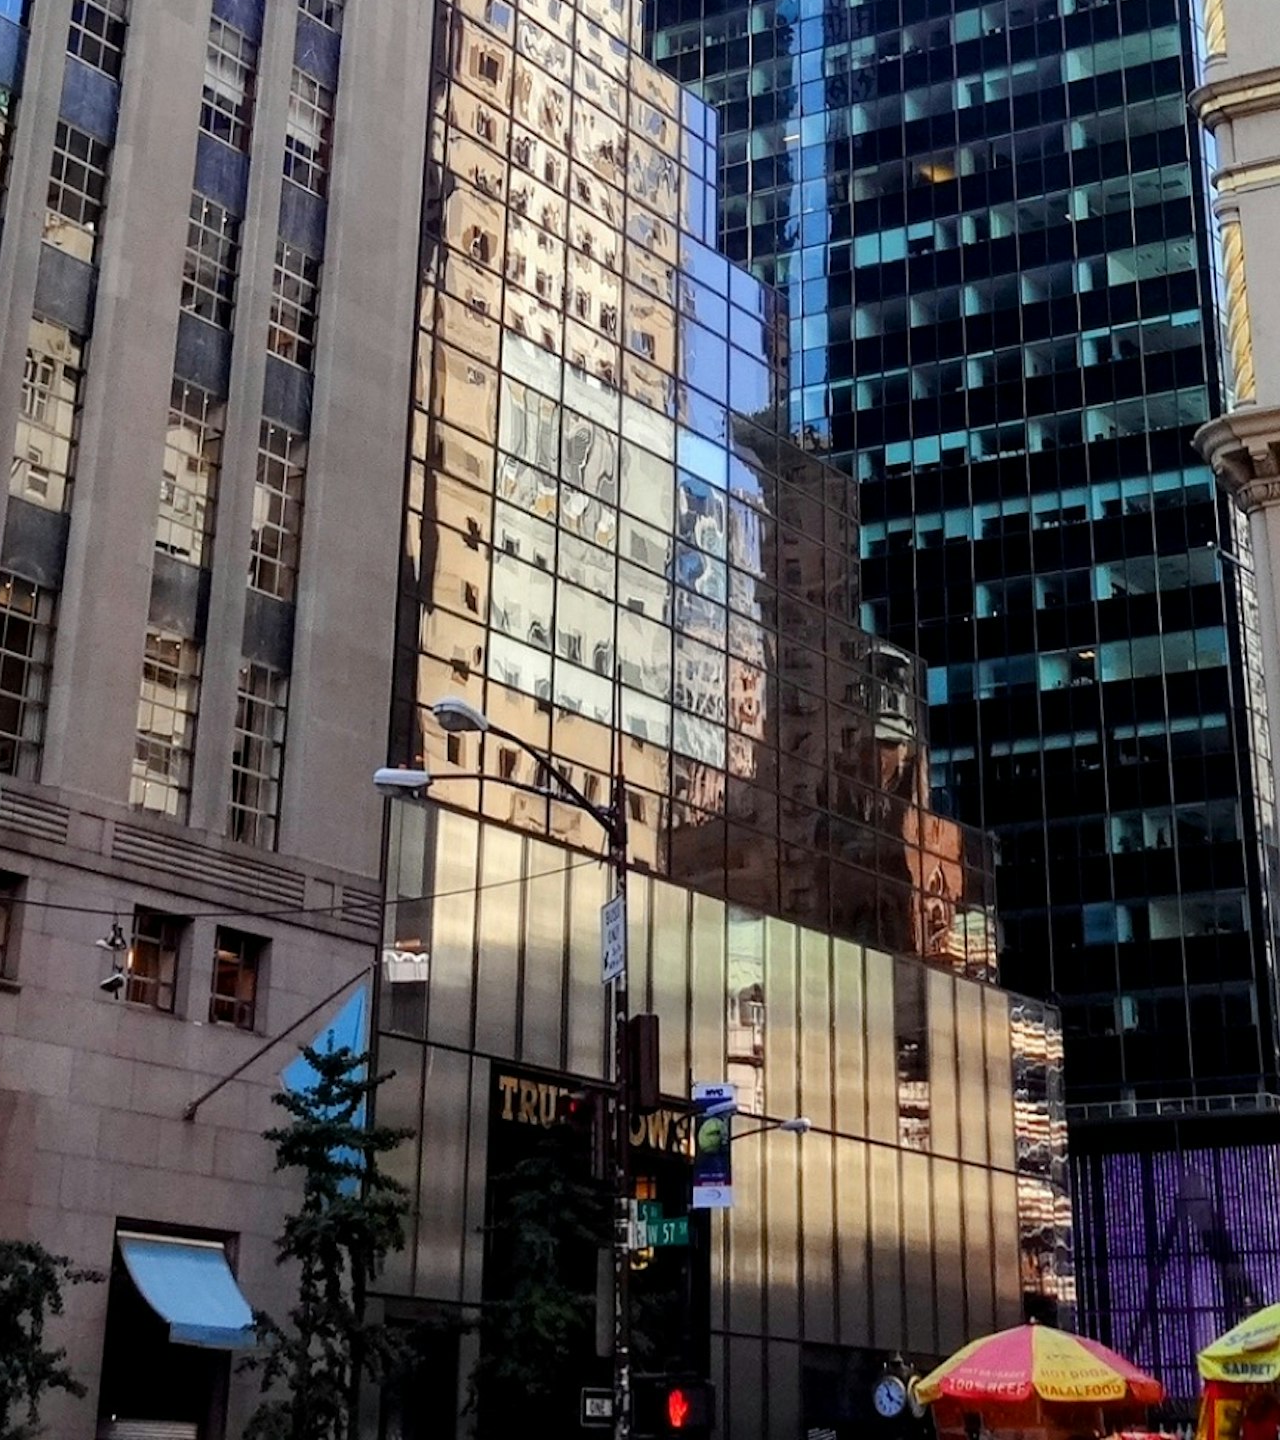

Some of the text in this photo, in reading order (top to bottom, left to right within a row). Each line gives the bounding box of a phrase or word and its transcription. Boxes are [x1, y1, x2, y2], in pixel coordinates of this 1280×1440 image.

[705, 1088, 724, 1097] NYC
[648, 1224, 659, 1245] W
[663, 1222, 676, 1245] 57
[991, 1381, 1025, 1395] BEEF
[1040, 1383, 1122, 1396] HALAL FOOD
